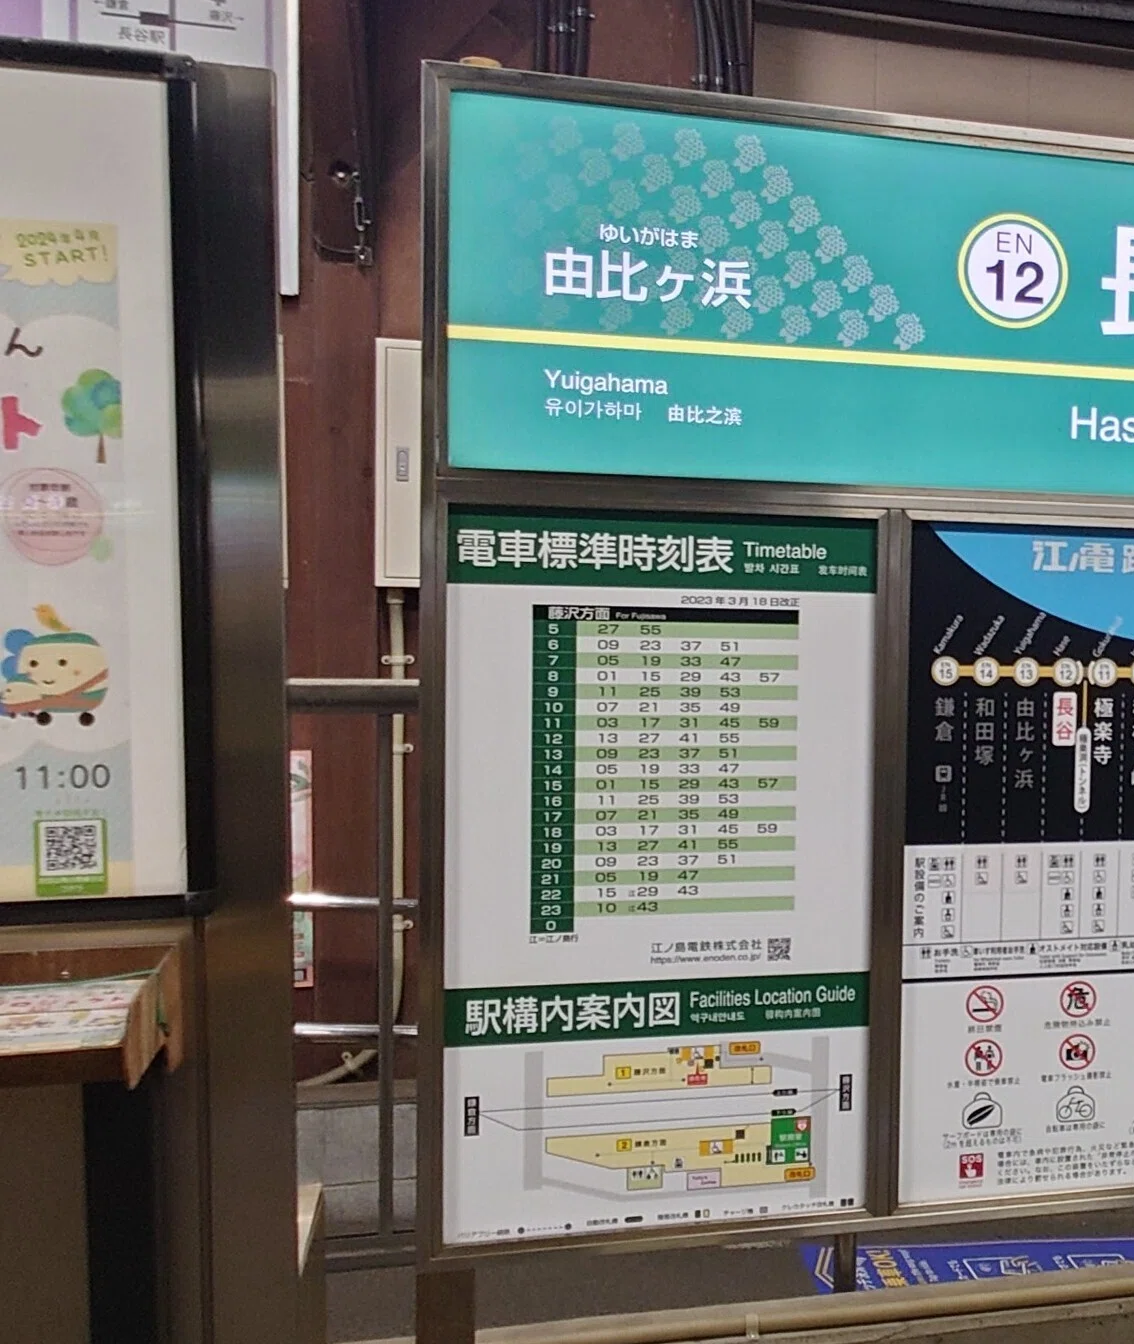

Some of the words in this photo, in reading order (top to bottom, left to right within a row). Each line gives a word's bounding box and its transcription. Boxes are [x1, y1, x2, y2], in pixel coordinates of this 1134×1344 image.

[599, 223, 699, 250] ゆいがはま
[996, 232, 1033, 255] EN
[24, 244, 108, 267] START!
[543, 250, 752, 311] 由比ヶ浜
[985, 259, 1045, 306] 12
[544, 369, 668, 397] Yuigahama
[544, 398, 643, 422] 유이가하마
[667, 403, 743, 427] 由比之滨
[457, 528, 734, 574] 電車標準時刻表
[742, 541, 828, 561] Timetable
[547, 606, 611, 621] 藤沢方面
[548, 623, 559, 635] 5
[597, 623, 620, 635] 27
[640, 624, 662, 636] 55
[933, 613, 965, 655] Kamakura
[973, 614, 1006, 656] Wadazuka
[547, 639, 559, 651] 6
[597, 639, 620, 651] 09
[639, 639, 662, 651] 23
[680, 640, 702, 652] 37
[720, 641, 739, 652] 51
[547, 654, 559, 666] 7
[597, 655, 620, 666] 05
[642, 655, 662, 667] 19
[680, 655, 702, 667] 33
[719, 656, 741, 667] 47
[547, 670, 559, 682] 8
[596, 670, 616, 682] 01
[641, 671, 661, 682] 15
[680, 671, 702, 683] 29
[719, 671, 741, 683] 43
[759, 672, 780, 683] 57
[934, 697, 955, 742] 鎌倉
[974, 697, 995, 766] 和田塚
[1055, 697, 1075, 740] 長谷
[1093, 697, 1114, 766] 極楽寺
[15, 763, 111, 790] 11:00
[913, 857, 925, 938] 駅設備のご案内
[651, 938, 763, 955] 江ノ島電鉄株式会社
[689, 990, 752, 1009] Facilities
[754, 987, 812, 1007] Location
[815, 984, 857, 1003] Guide
[465, 991, 681, 1036] 駅構内案内図
[961, 1154, 983, 1164] SOS
